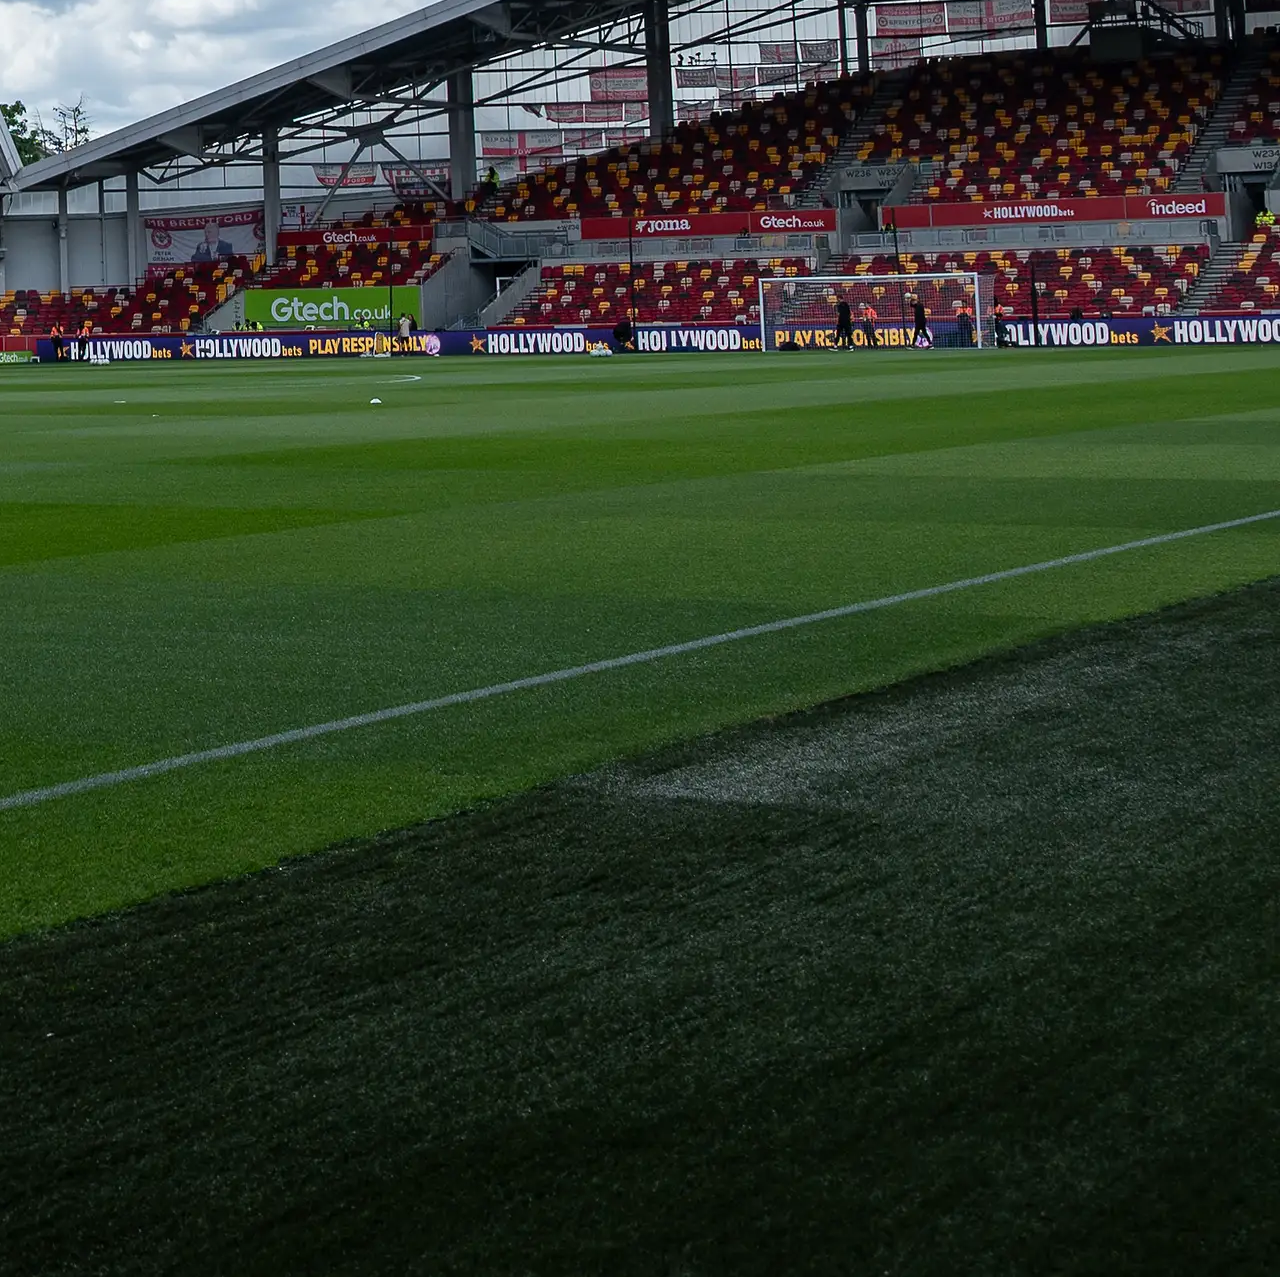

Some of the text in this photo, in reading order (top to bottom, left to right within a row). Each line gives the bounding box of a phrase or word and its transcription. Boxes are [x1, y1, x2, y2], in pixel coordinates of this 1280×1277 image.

[879, 179, 897, 187] W13
[1151, 198, 1206, 215] indeed
[760, 215, 825, 229] Gtech.co.uk
[323, 230, 377, 244] Gtech.co.uk
[271, 296, 391, 322] Gtech.co.uk
[1004, 322, 1139, 346] OLLYWOODbets
[309, 335, 427, 354] PLAY RESPNSLY
